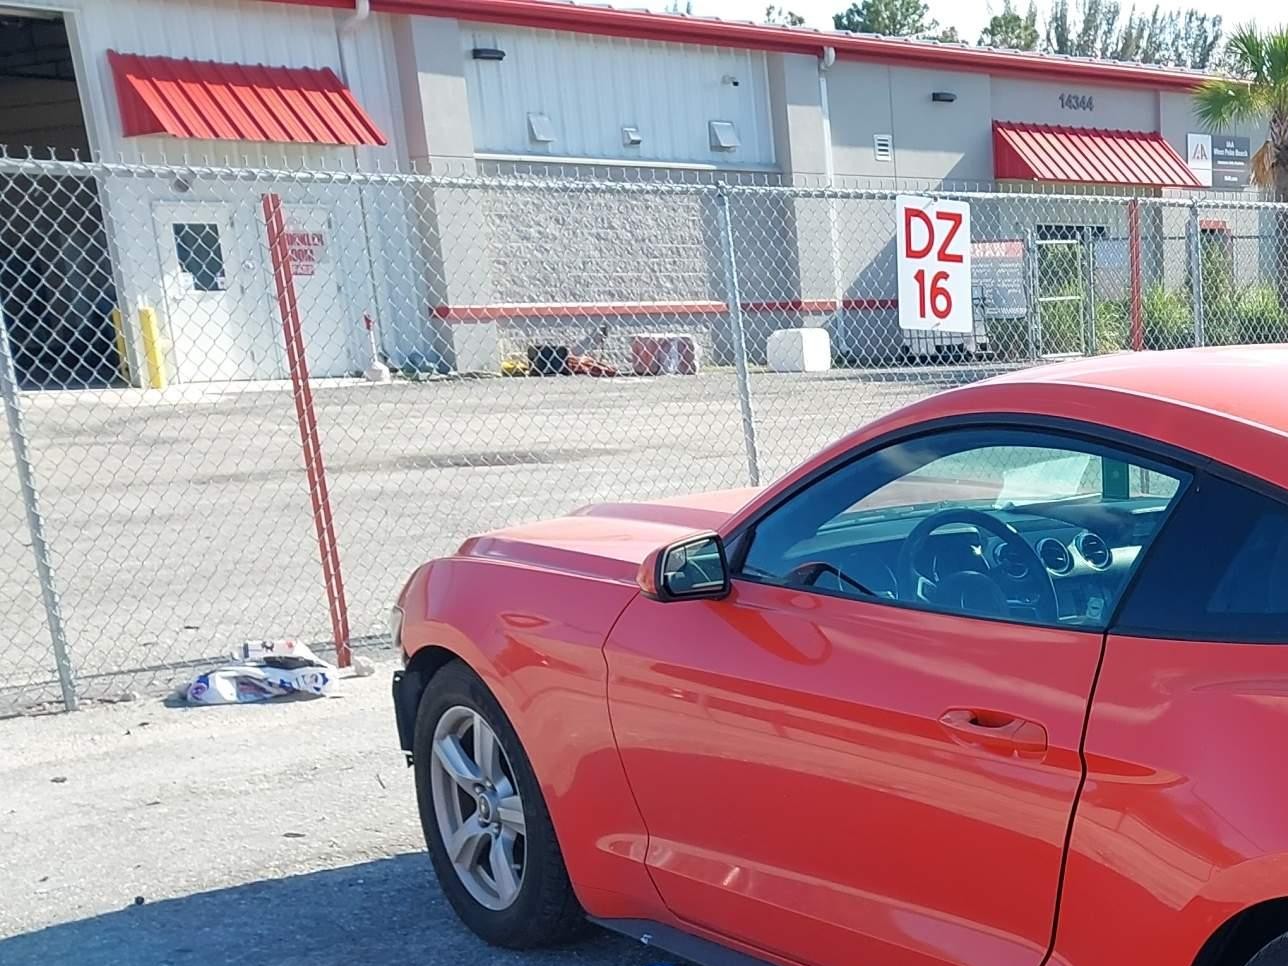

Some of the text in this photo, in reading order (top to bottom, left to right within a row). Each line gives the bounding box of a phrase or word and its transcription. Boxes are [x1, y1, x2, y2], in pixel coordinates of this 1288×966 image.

[1059, 93, 1095, 111] 14344
[904, 207, 963, 263] DZ
[914, 269, 952, 319] 16
